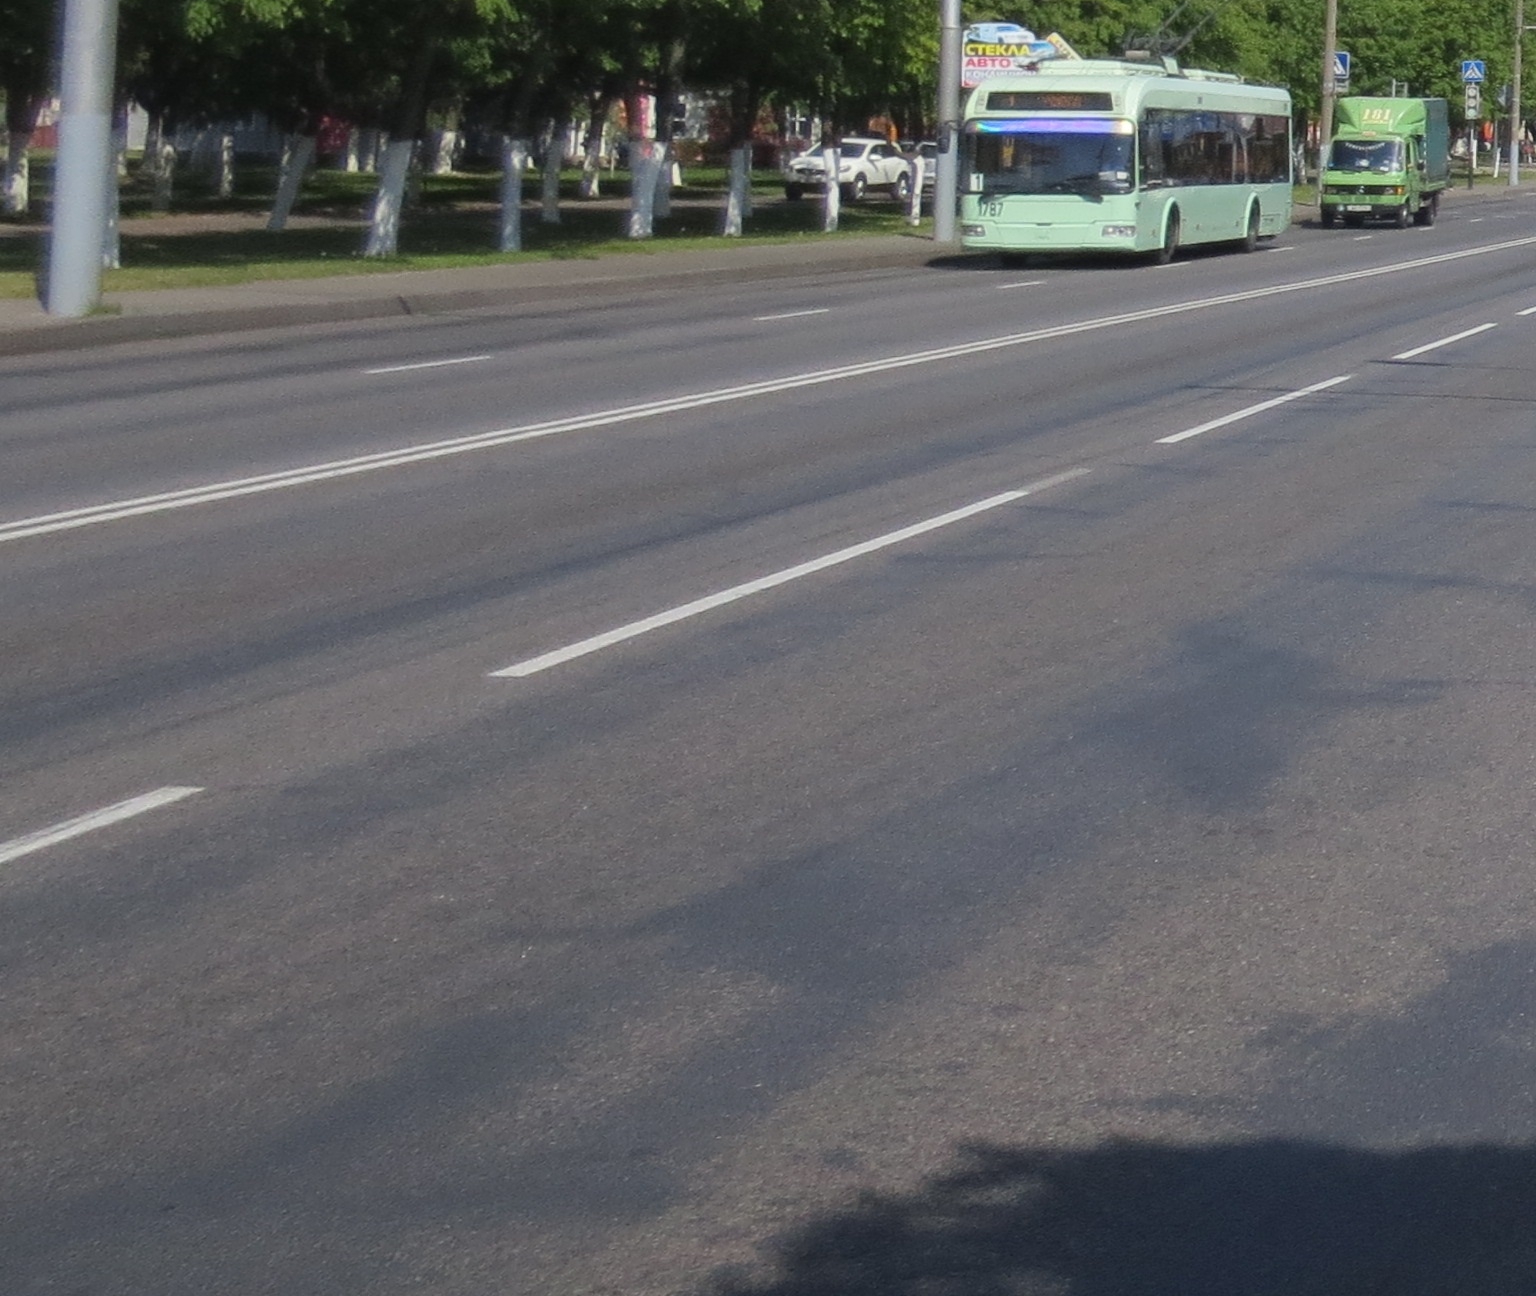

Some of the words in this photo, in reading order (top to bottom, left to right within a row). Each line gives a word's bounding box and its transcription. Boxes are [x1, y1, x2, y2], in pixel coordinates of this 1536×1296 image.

[966, 45, 1031, 56] СТЕКЛА
[966, 58, 1011, 68] АВТО
[1362, 108, 1391, 120] 181
[979, 202, 1003, 217] 1787
